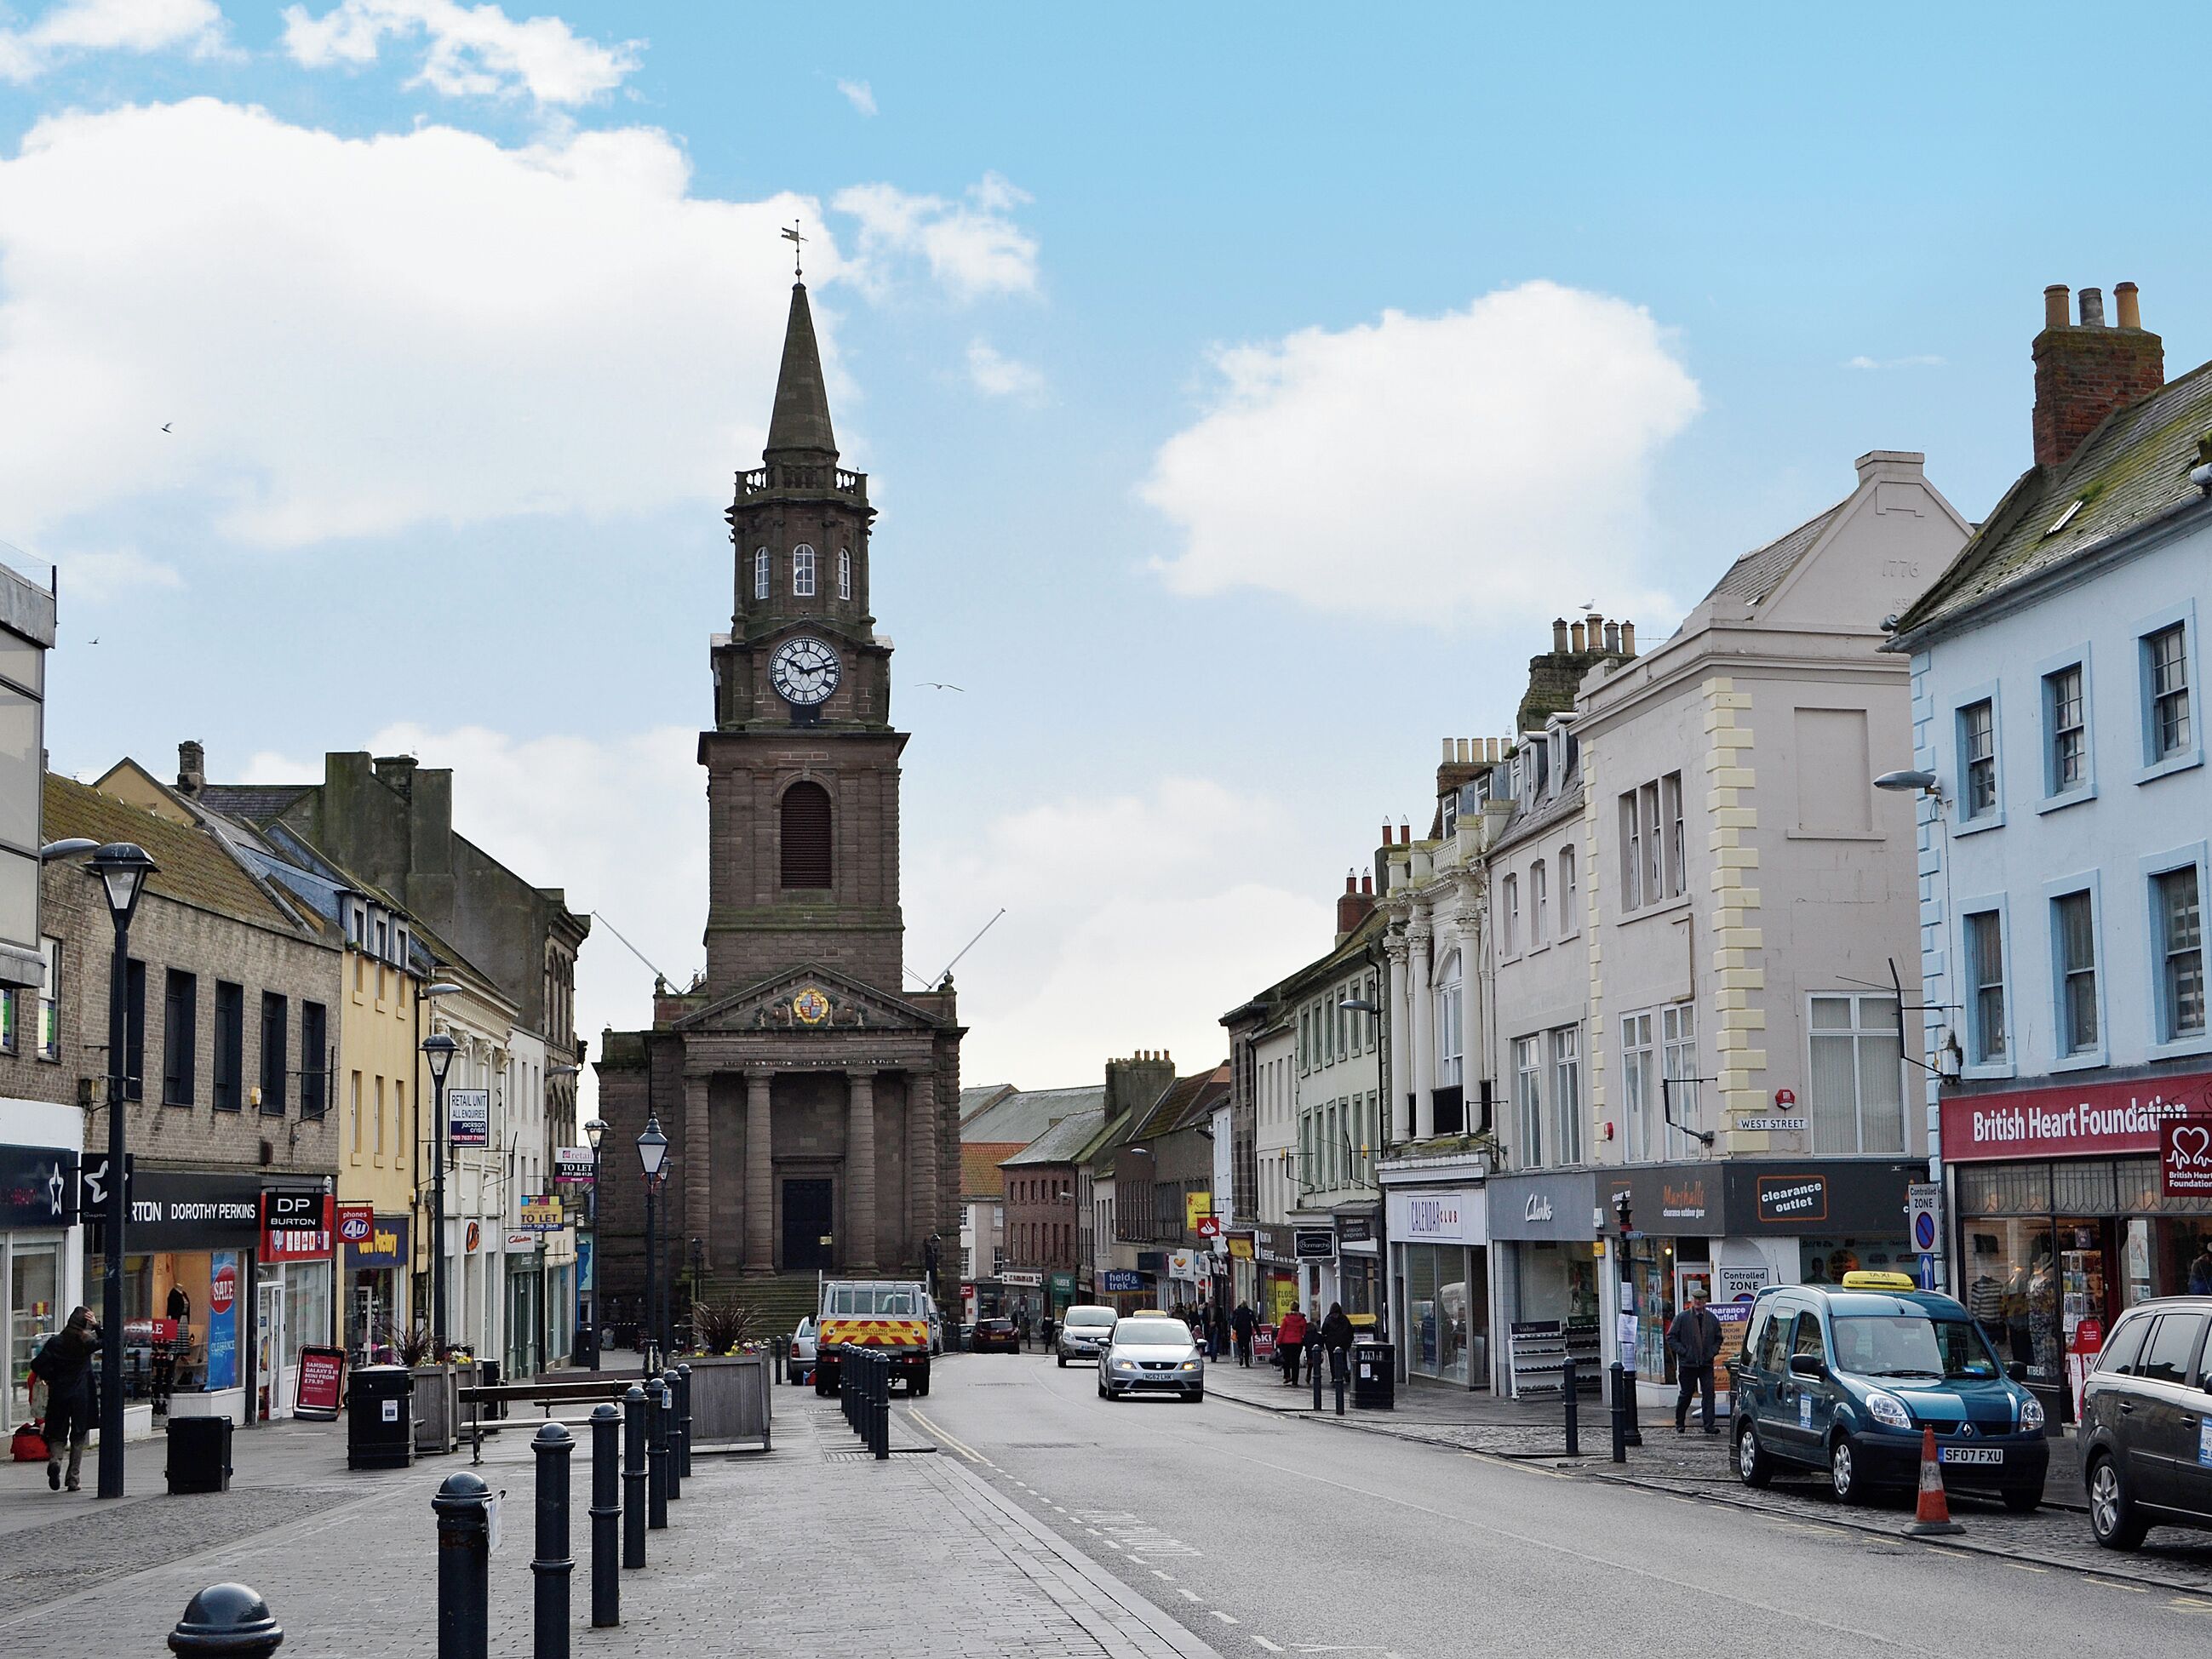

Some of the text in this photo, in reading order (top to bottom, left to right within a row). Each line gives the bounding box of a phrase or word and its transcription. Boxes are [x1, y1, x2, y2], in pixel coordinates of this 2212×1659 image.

[452, 1095, 486, 1107] RETAIL UNIT
[1741, 1119, 1804, 1129] WEST STREET
[1973, 1107, 2025, 1142] British
[2028, 1107, 2077, 1139] Heart
[576, 1164, 593, 1172] LET
[1761, 1182, 1822, 1203] clearance
[1910, 1187, 1937, 1196] Controlled
[278, 1198, 311, 1212] DP
[1525, 1193, 1552, 1222] Clarks
[1775, 1197, 1814, 1213] outlet
[1914, 1198, 1934, 1209] ZONE
[132, 1201, 162, 1221] RTON
[171, 1203, 255, 1220] DOROTHY PERKINS
[1411, 1201, 1458, 1232] CALENDAR CLUB
[521, 1214, 558, 1223] TO LET
[1109, 1273, 1138, 1284] field &
[214, 1280, 234, 1301] SALE
[1729, 1281, 1759, 1290] ZONE
[1254, 1334, 1272, 1342] SKI
[1945, 1449, 2002, 1462] SF07 FXU
